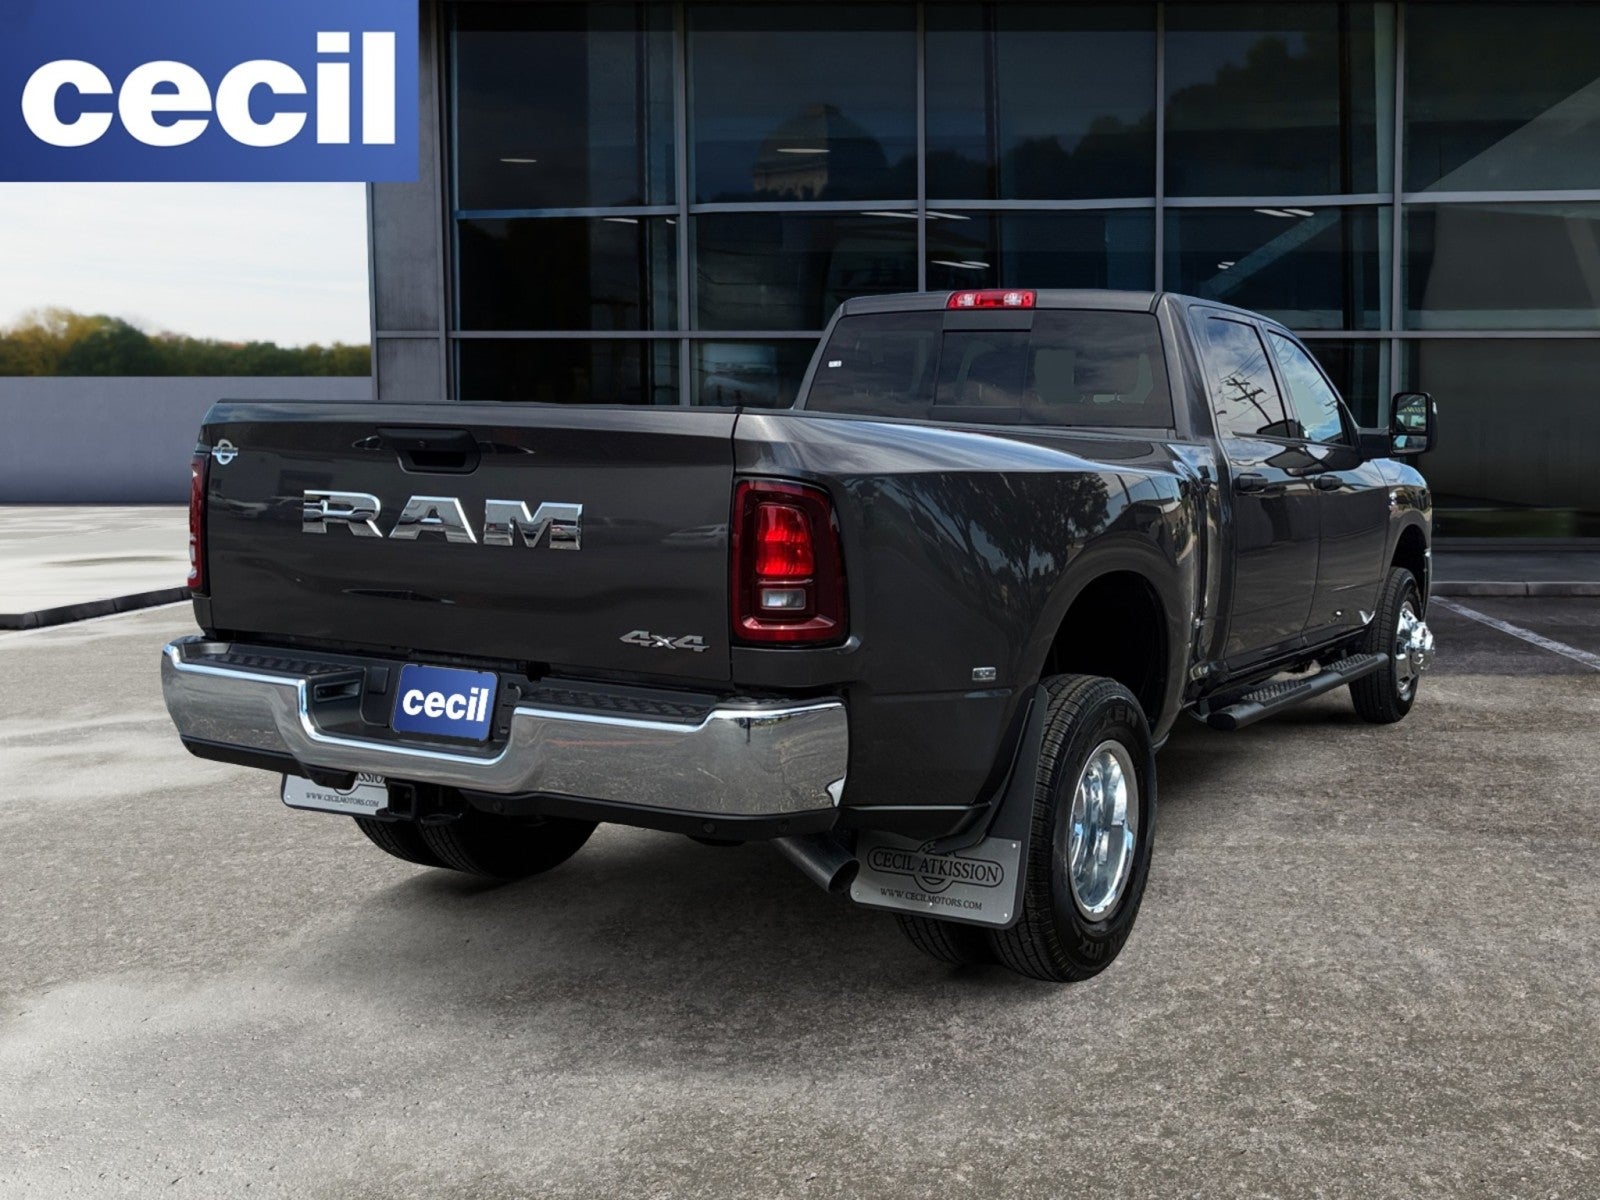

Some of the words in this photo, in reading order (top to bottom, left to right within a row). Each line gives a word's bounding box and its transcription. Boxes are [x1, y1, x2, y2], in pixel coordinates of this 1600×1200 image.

[302, 489, 584, 551] RAM
[620, 630, 709, 653] 4x4
[402, 687, 490, 723] cecil
[873, 851, 915, 872] CECIL
[918, 856, 999, 883] ATKISSION
[880, 887, 983, 910] WWW.CECILMOTORS.COM
